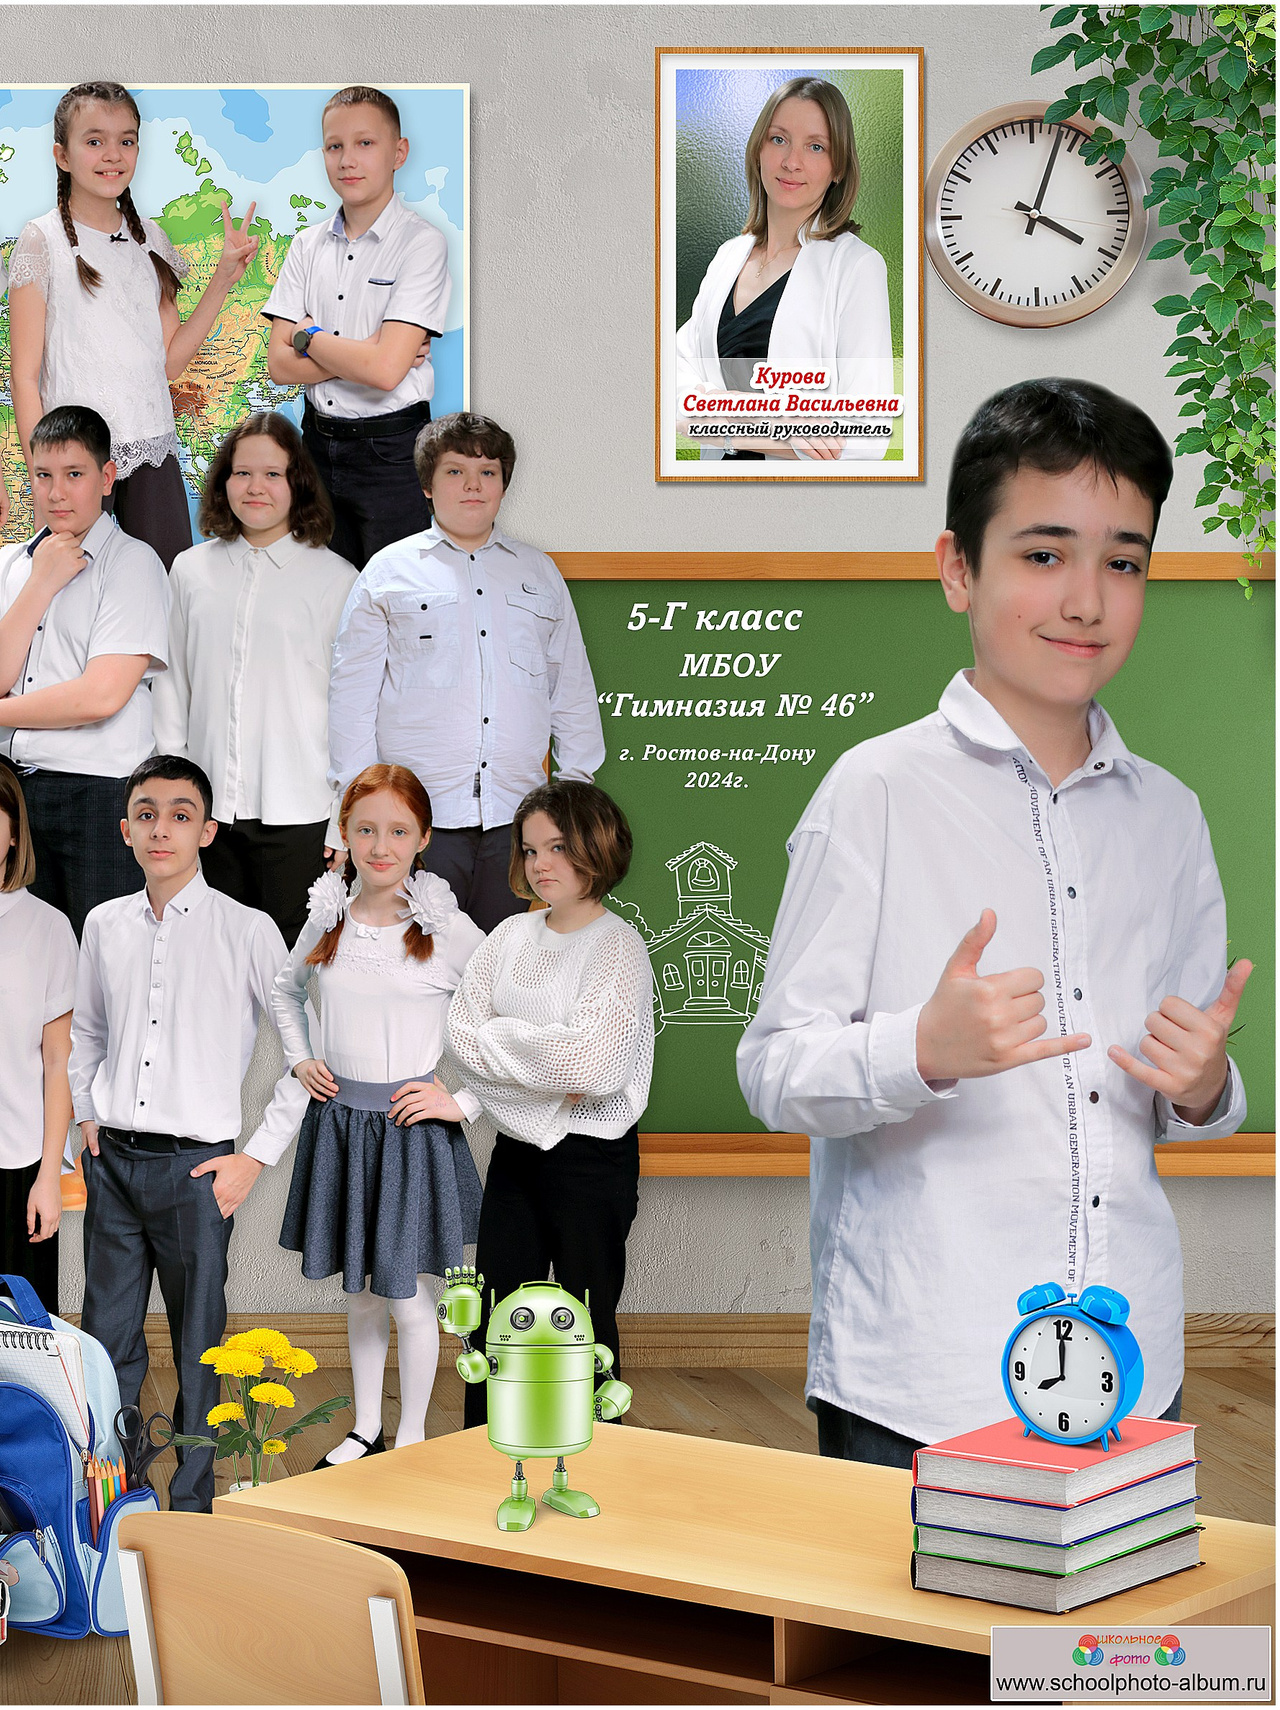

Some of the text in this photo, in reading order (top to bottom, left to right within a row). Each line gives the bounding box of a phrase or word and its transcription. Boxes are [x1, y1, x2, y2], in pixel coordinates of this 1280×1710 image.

[627, 602, 803, 631] 5-Г класс
[679, 653, 782, 678] МБОУ
[774, 693, 812, 717] №
[619, 744, 816, 765] г. Ростов-на-Дону
[684, 772, 749, 789] 2024г.
[1038, 846, 1048, 860] OF
[1043, 860, 1053, 875] AN
[1047, 878, 1057, 916] URBAN
[1050, 919, 1062, 989] GENERATION
[1062, 1057, 1071, 1072] OF
[1064, 1073, 1074, 1090] AN
[1067, 1093, 1077, 1131] URBAN
[1069, 1132, 1080, 1203] GENERATION
[1068, 1204, 1079, 1268] MOVEMENT
[1067, 1269, 1076, 1282] OF
[1053, 1320, 1073, 1341] 12
[1014, 1361, 1113, 1393] 9 3
[1058, 1412, 1070, 1432] 6
